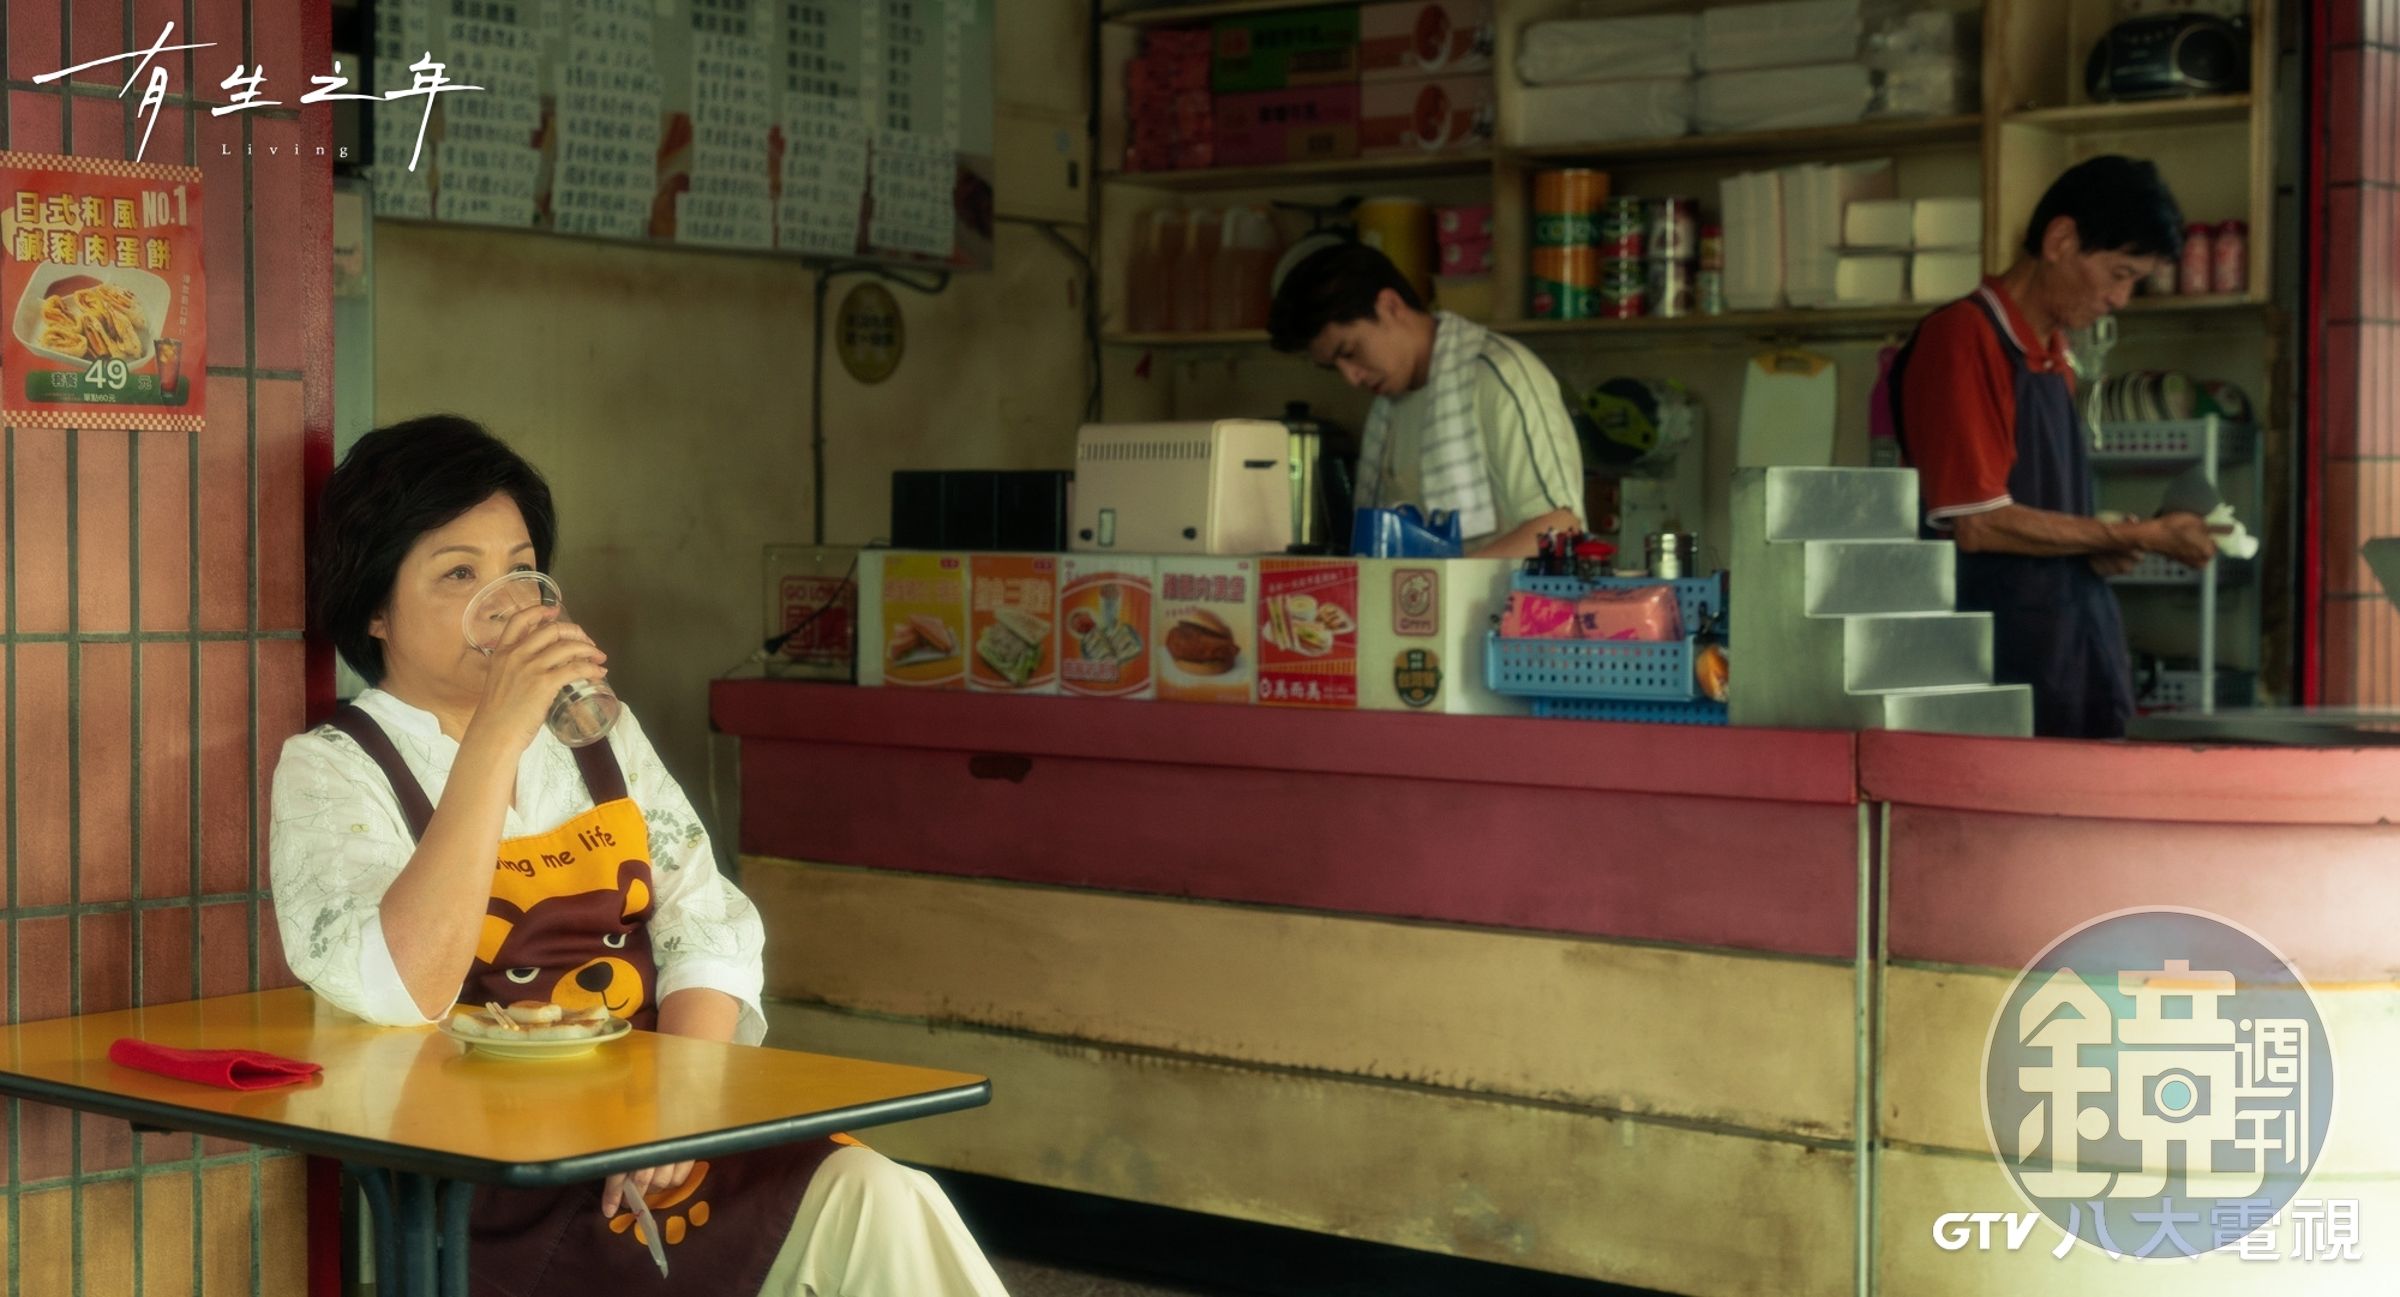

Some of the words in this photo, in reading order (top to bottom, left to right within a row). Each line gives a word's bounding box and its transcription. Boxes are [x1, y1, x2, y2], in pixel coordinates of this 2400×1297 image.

[16, 191, 138, 230] 日式和風
[142, 185, 187, 228] NO.1
[15, 228, 172, 270] 鹹豬肉蛋餅
[85, 358, 127, 390] 49
[496, 856, 536, 877] ing
[541, 851, 576, 868] me
[578, 825, 616, 852] life
